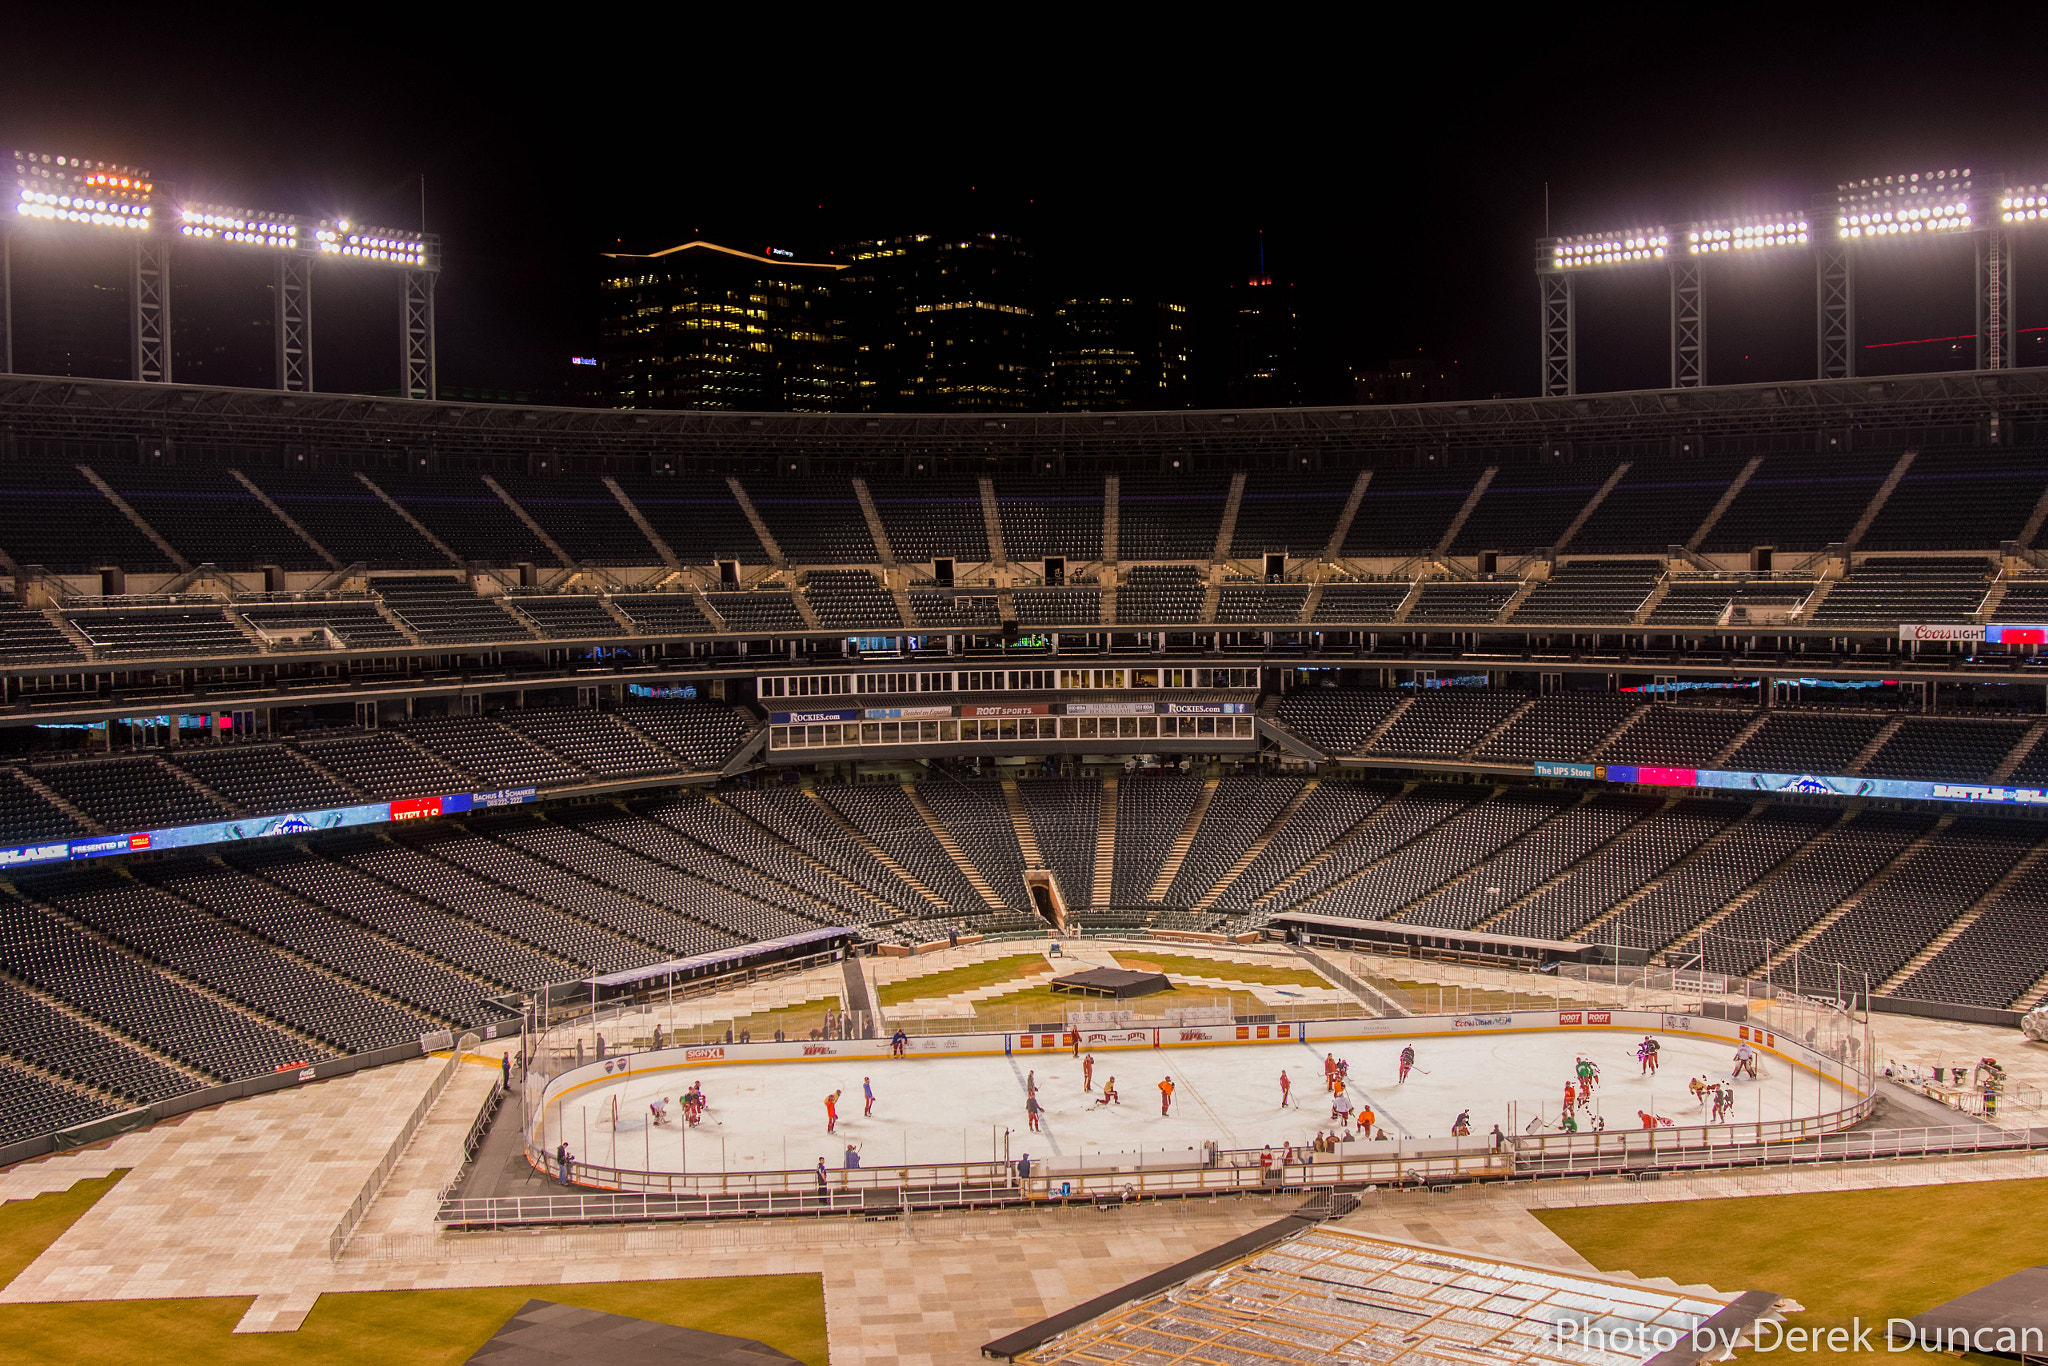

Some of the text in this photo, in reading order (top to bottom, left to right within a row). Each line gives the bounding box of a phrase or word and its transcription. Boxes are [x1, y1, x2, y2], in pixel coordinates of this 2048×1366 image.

[1915, 625, 1985, 639] Coors LIGHT
[976, 706, 1033, 716] ROOT SPORTS
[1168, 703, 1221, 713] ROCKIES.com
[789, 712, 841, 722] ROCKIES.com
[1537, 766, 1592, 777] The UPS Store
[473, 792, 497, 801] BACHUS
[498, 790, 504, 798] &
[71, 840, 129, 853] PRESENTED BY
